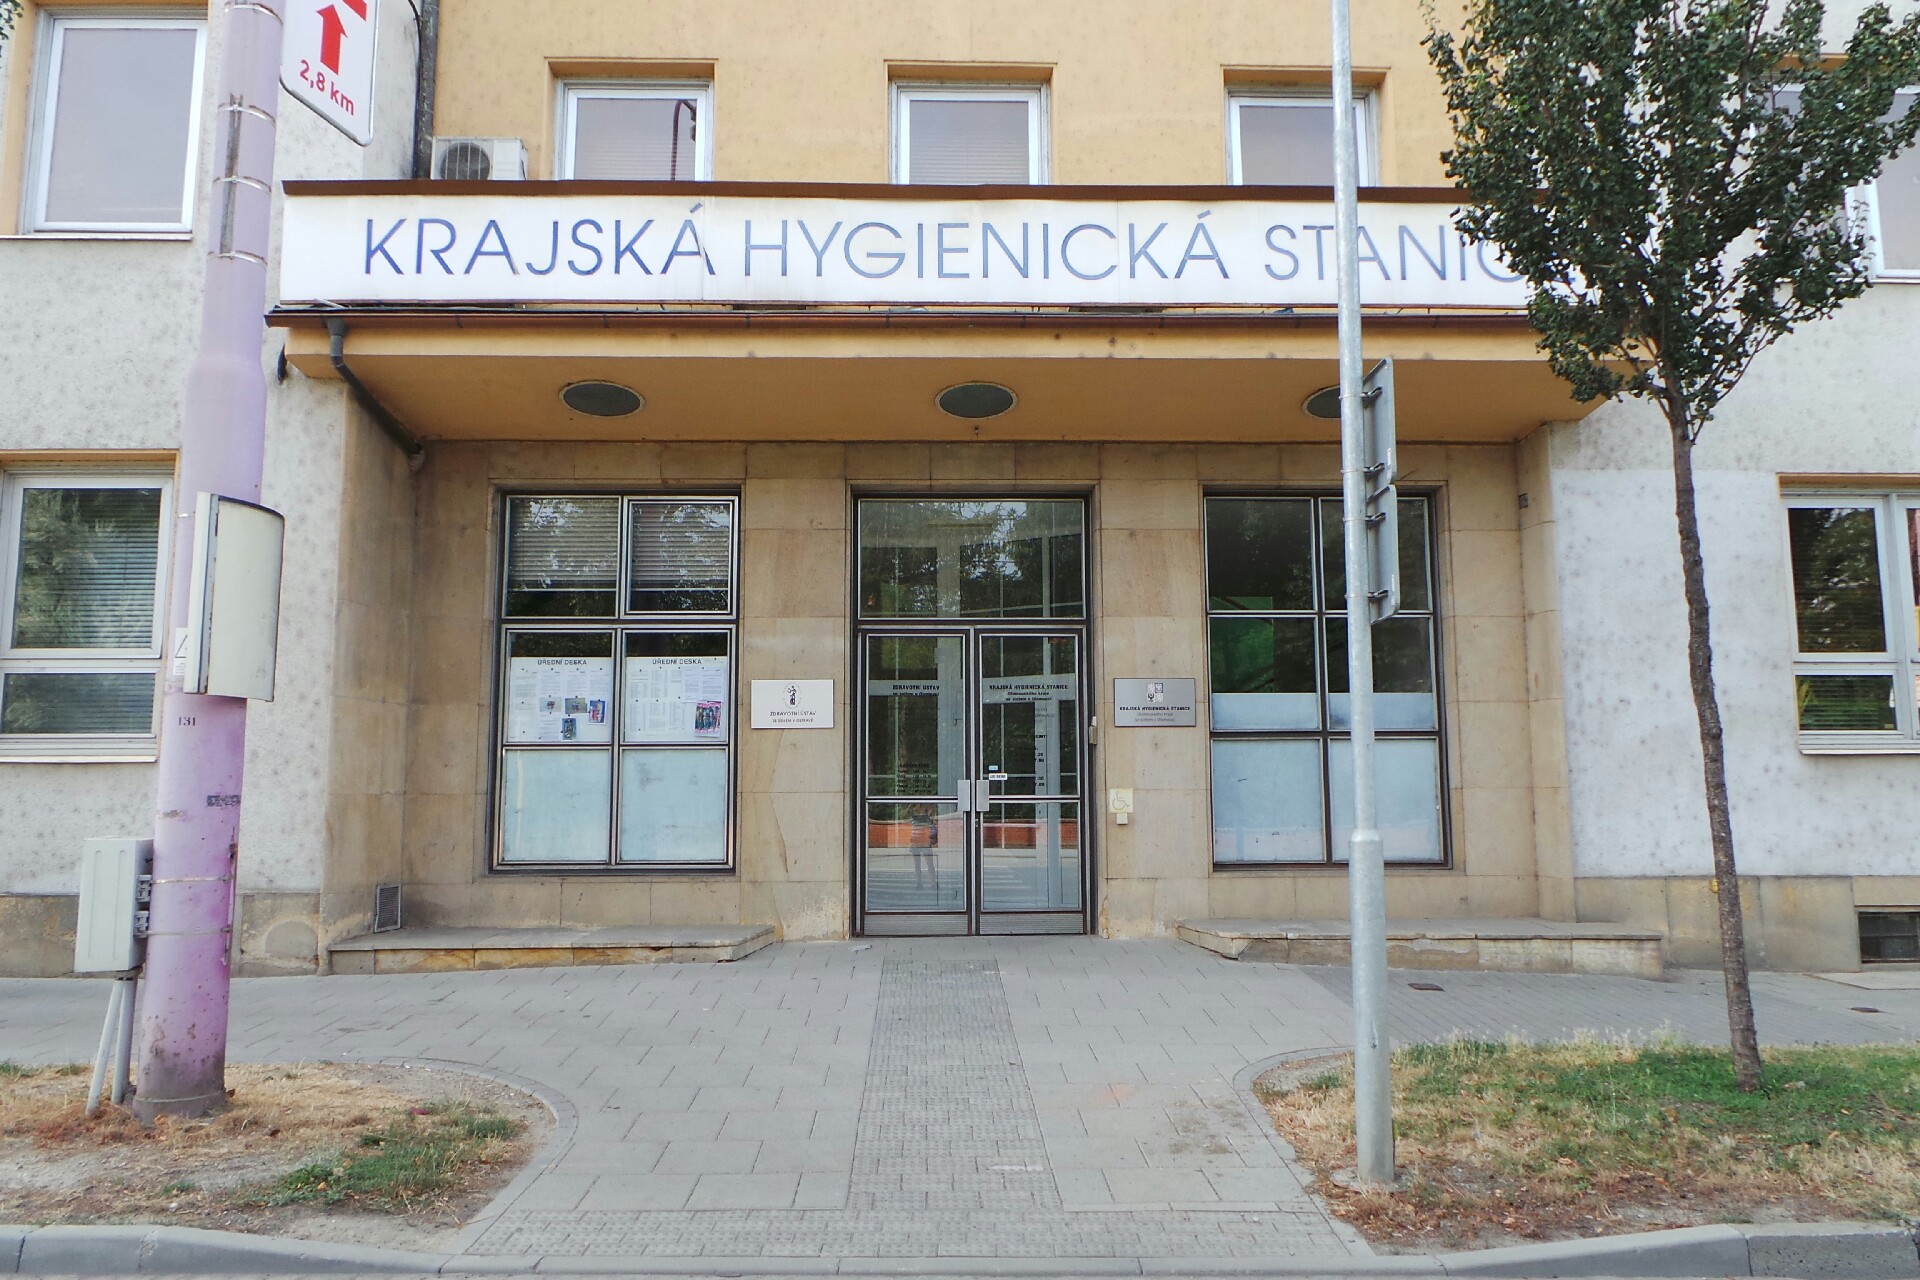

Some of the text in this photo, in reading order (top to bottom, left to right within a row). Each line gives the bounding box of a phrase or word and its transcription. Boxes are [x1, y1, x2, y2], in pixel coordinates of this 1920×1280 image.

[300, 59, 354, 116] 2,8 km
[365, 202, 1576, 281] KRAJSKÁ HYGIENICKÁ STANIC
[178, 716, 197, 727] 131
